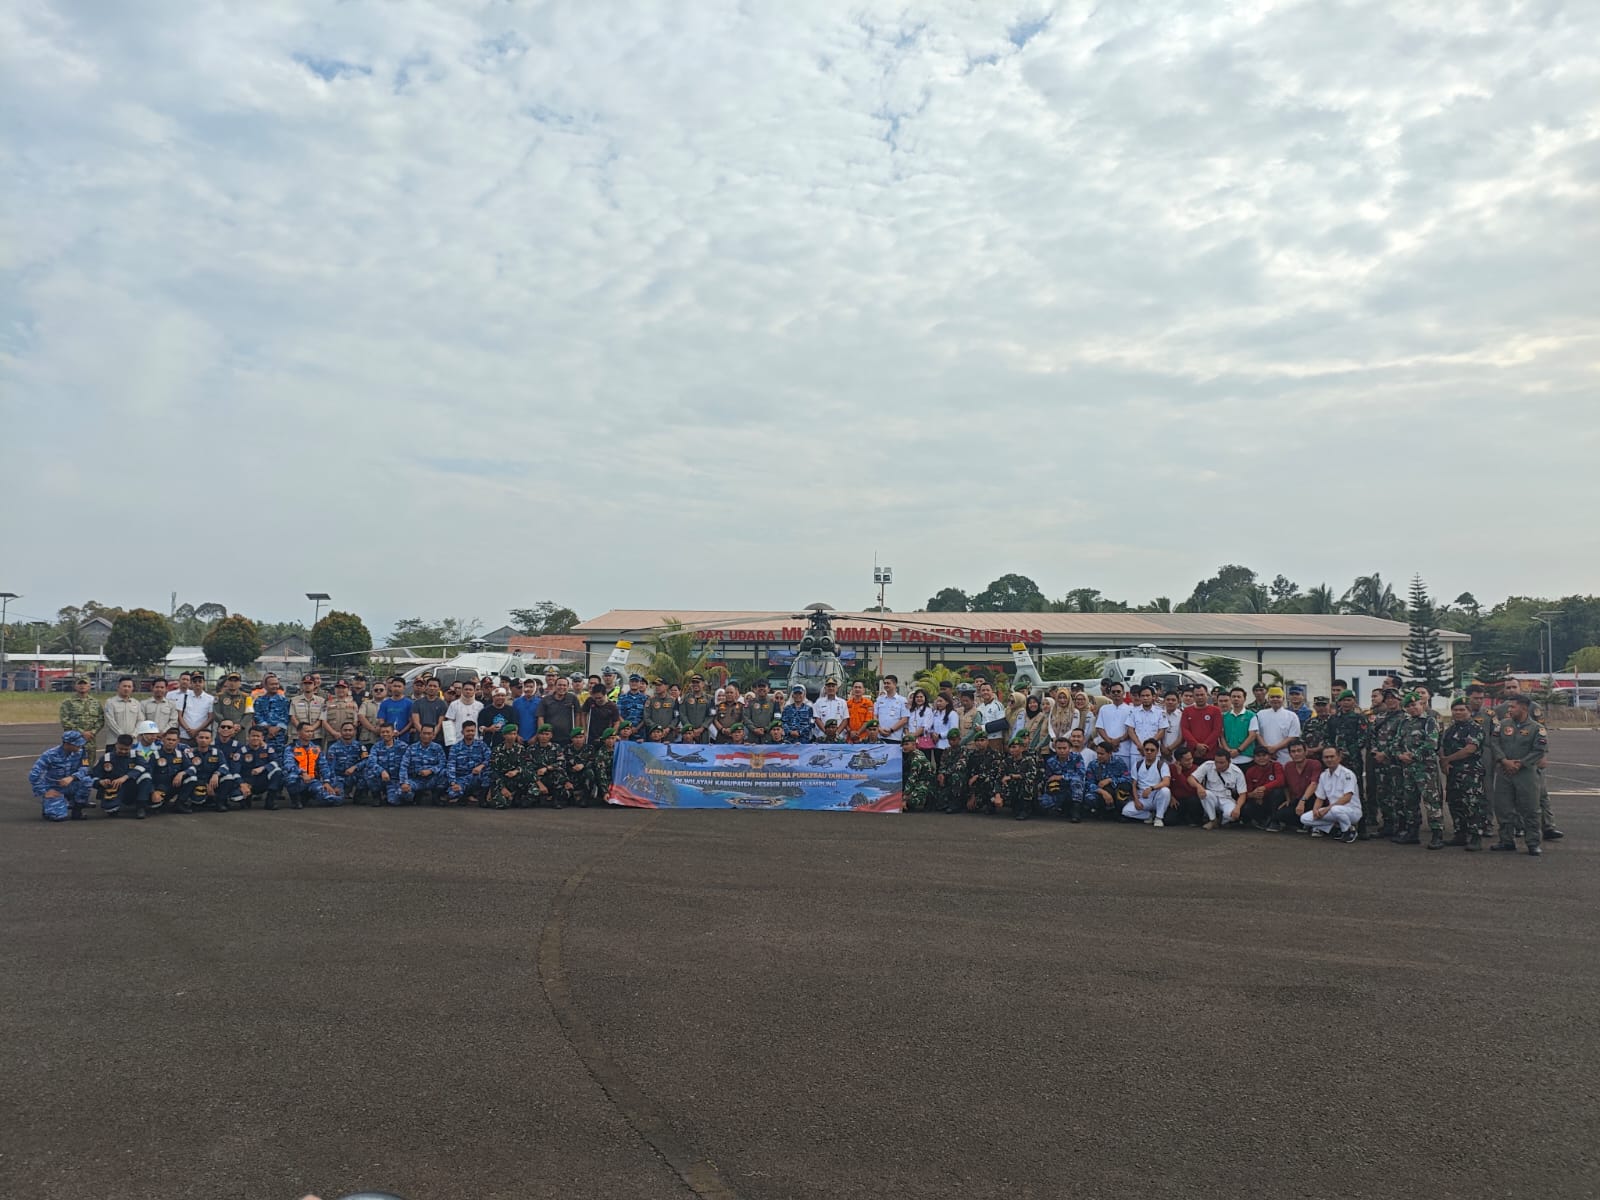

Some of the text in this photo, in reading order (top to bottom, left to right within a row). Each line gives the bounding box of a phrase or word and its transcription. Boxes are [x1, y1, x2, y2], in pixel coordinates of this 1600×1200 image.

[729, 630, 775, 640] UDARA
[781, 627, 892, 641] MUMMAD
[970, 628, 1043, 642] KIEMAS
